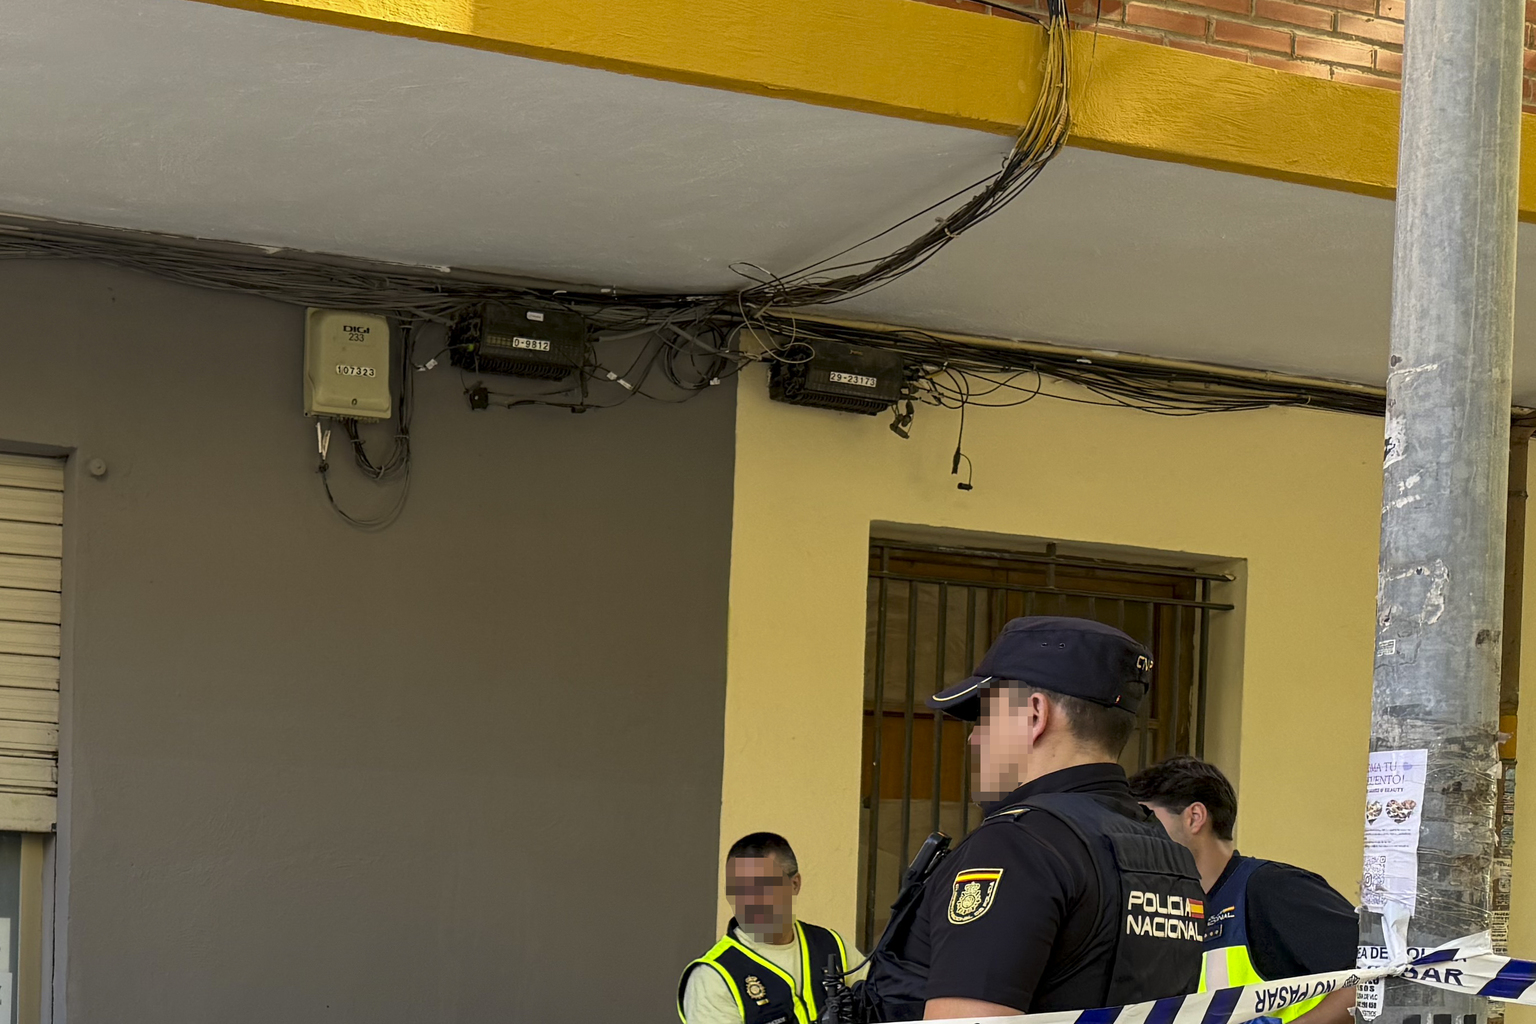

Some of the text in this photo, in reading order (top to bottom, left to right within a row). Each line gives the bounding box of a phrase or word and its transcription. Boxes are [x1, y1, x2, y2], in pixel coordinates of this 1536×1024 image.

[342, 325, 370, 334] DIGI
[348, 332, 365, 342] 233
[337, 366, 375, 377] 107323
[830, 372, 876, 387] 29-23173
[1128, 890, 1192, 917] POLICIA
[1126, 914, 1204, 942] NACIONAL
[1255, 982, 1309, 1014] PASAR
